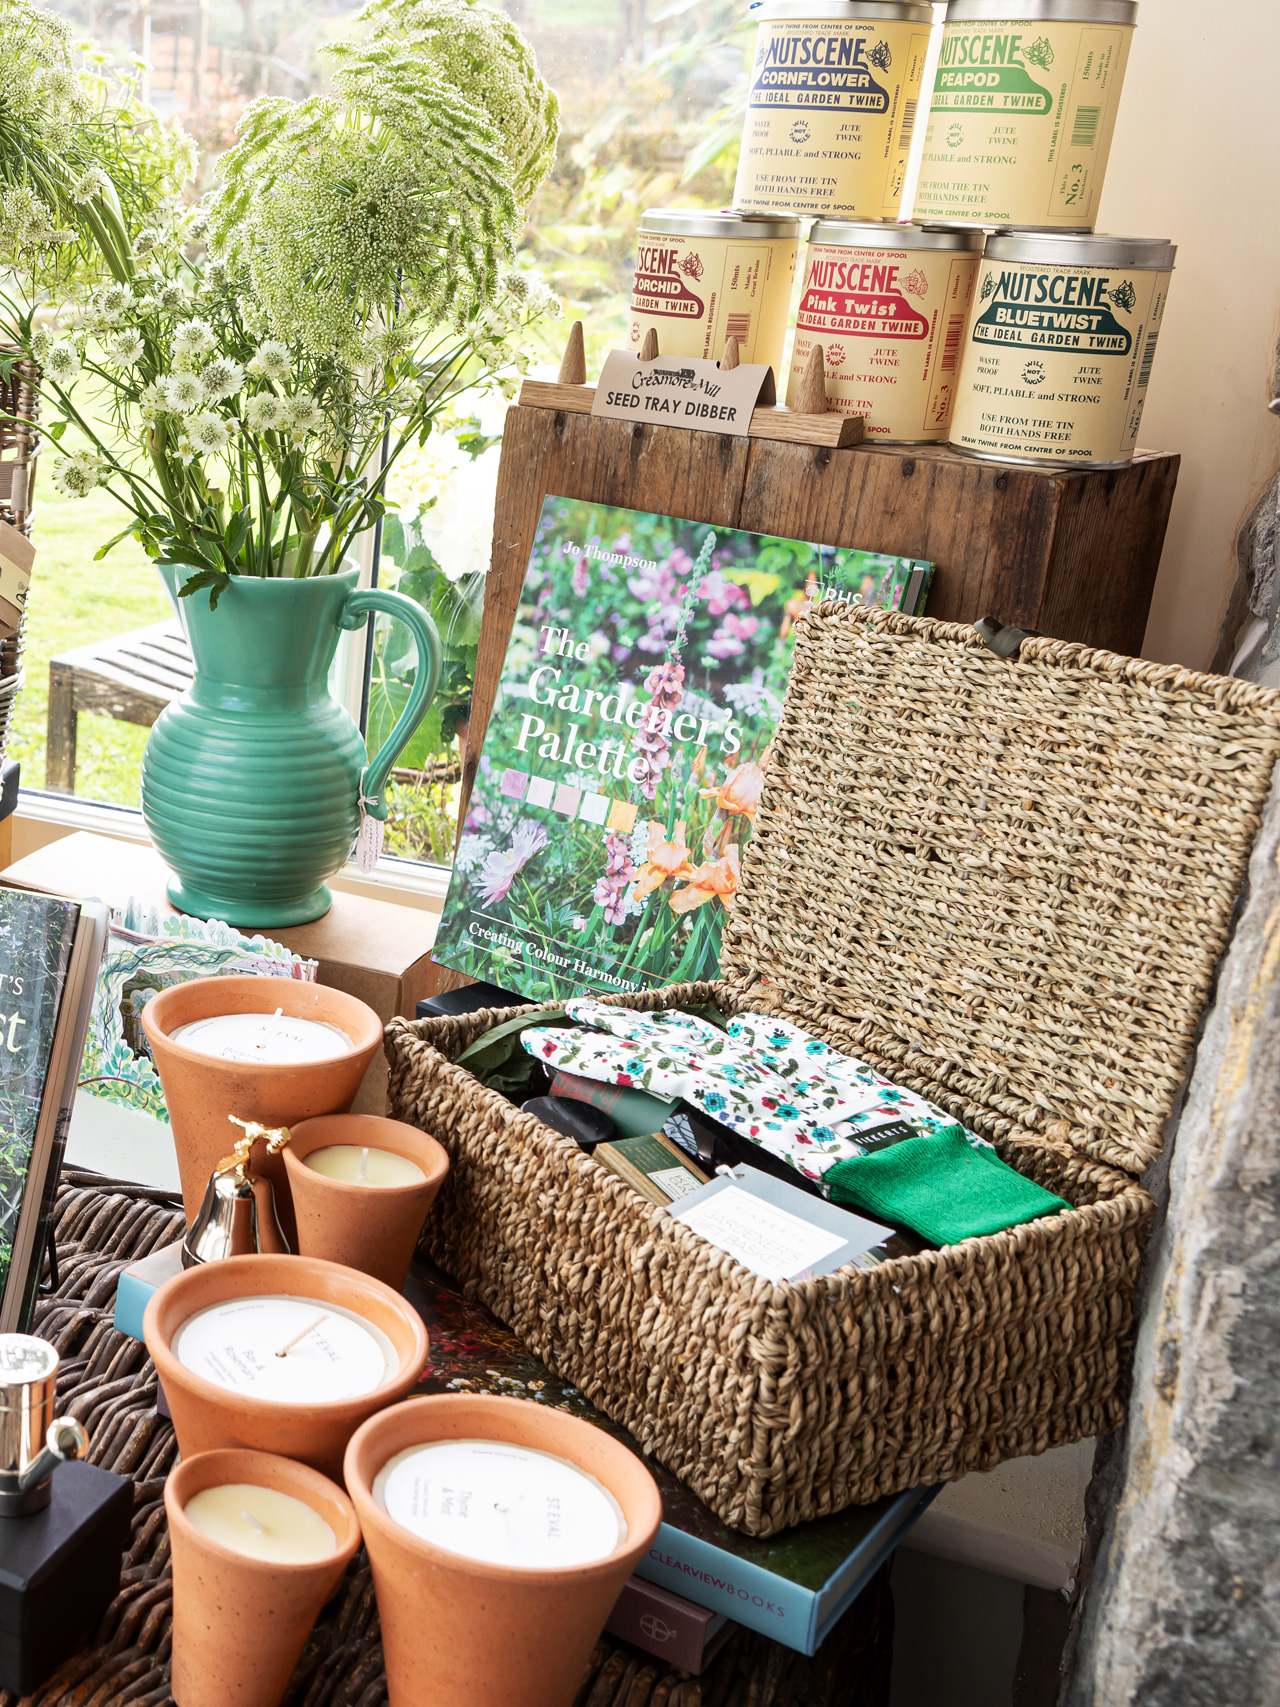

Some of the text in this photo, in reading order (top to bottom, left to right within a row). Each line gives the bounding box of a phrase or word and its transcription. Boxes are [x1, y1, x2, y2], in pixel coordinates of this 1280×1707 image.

[764, 38, 868, 70] NUTSCENE
[762, 72, 870, 87] CORNFLOWER
[941, 73, 1000, 86] PEAPOD
[766, 93, 882, 106] IDEAL GARDEN TWINE
[954, 96, 1042, 107] GARDEN TWINE
[988, 137, 1018, 145] TWINE
[766, 149, 861, 160] PLIABLE STRONG
[974, 156, 1016, 164] STRONG
[639, 279, 681, 294] ORCHID
[731, 265, 740, 290] 150mts
[807, 260, 902, 296] NUTSCENE
[992, 272, 1110, 311] NUTSCENE
[665, 301, 695, 312] TWINE
[807, 295, 896, 316] Pink Twist
[806, 313, 920, 333] IDEAL GARDEN TWINE
[996, 308, 1102, 330] BLUETWIST
[977, 326, 1124, 348] THE IDEAL GARDEN TWINE
[869, 358, 900, 366] TWINE
[632, 371, 721, 398] Creamore Mill
[839, 372, 854, 381] and
[856, 374, 897, 384] STRONG
[1073, 377, 1102, 385] TWINE
[856, 400, 873, 408] TIN
[994, 387, 1101, 403] PLIABLE and STRONG
[606, 392, 737, 421] SEED TRAY DIBBER
[982, 412, 1074, 430] USE FROM THE TIN
[980, 424, 1071, 441] BOTH HANDS FREE
[978, 439, 997, 448] TWINE
[1024, 445, 1053, 453] CENTRE
[563, 541, 657, 570] Jo Thompson
[539, 624, 590, 662] The
[528, 665, 743, 754] Gardener's
[512, 712, 650, 784] Palette
[469, 922, 638, 994] Creating Colour Harmony
[692, 1218, 790, 1268] GIFT BASKET
[703, 1210, 799, 1262] GARDENER'S
[316, 1340, 341, 1362] EVAL
